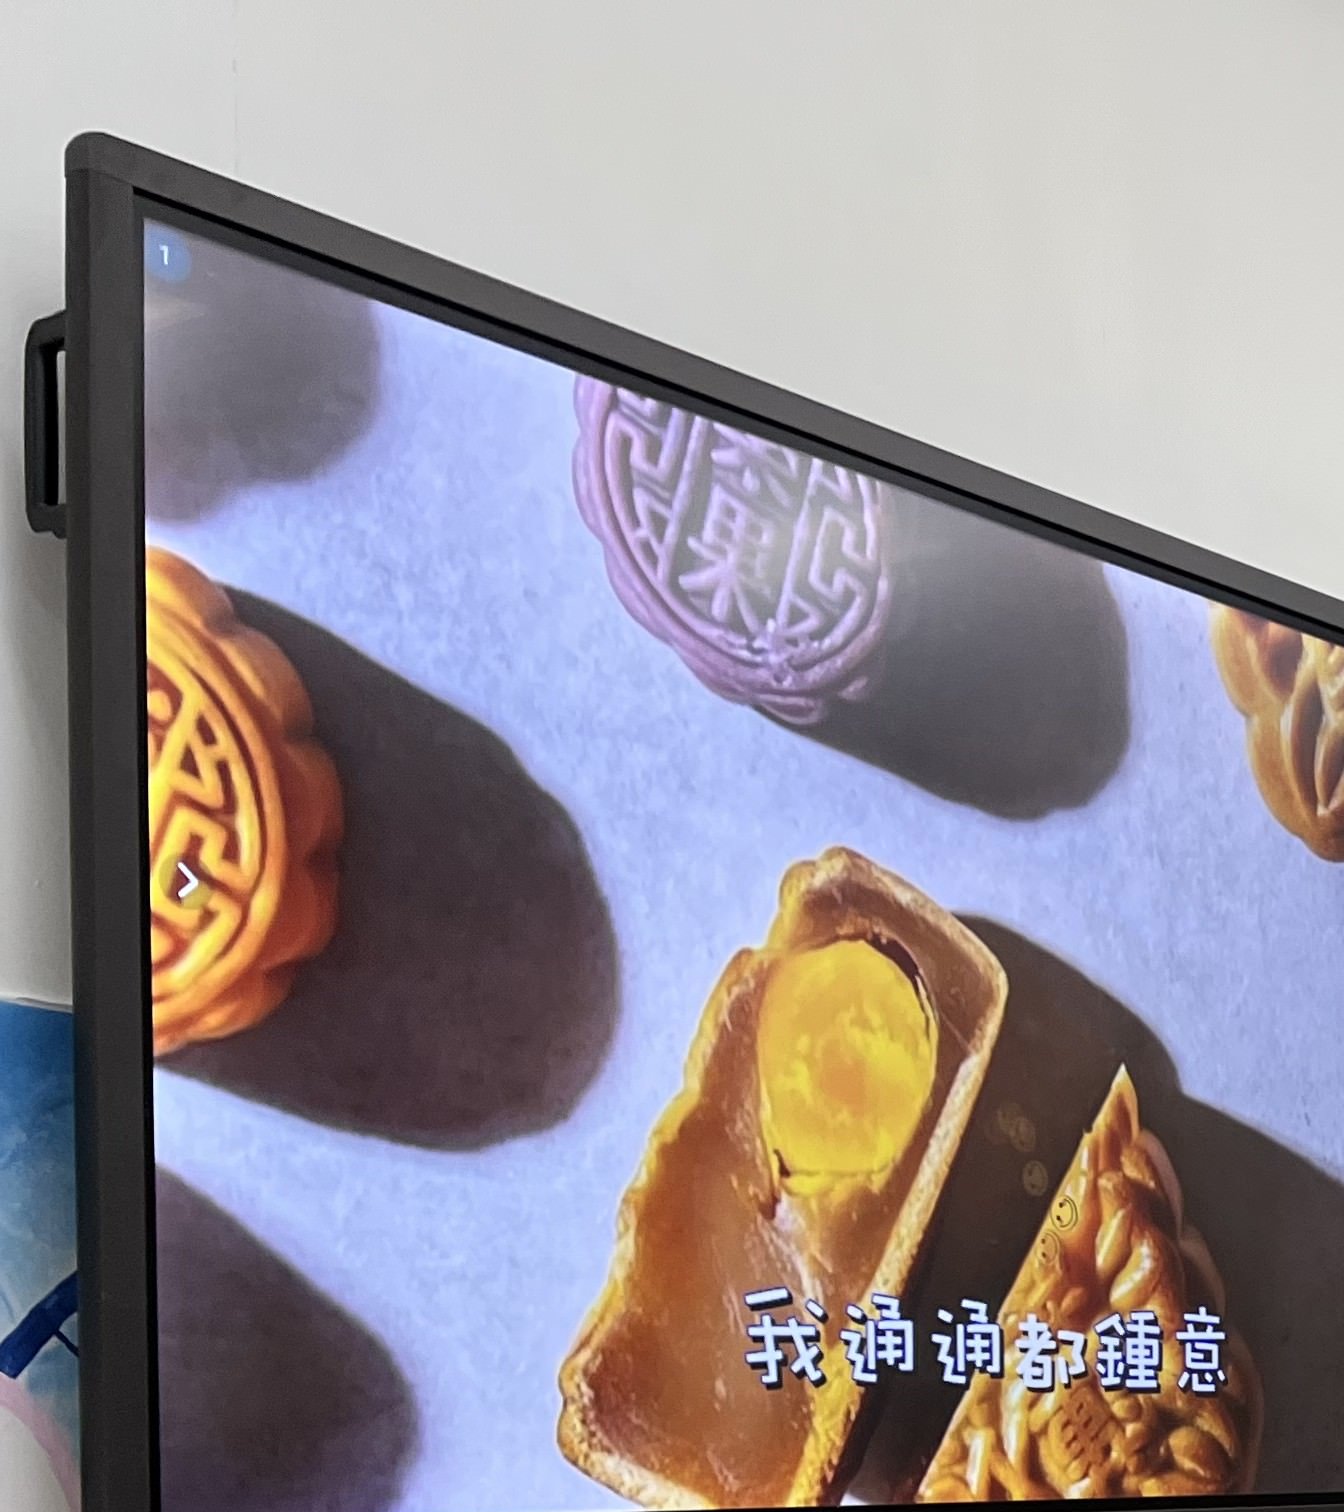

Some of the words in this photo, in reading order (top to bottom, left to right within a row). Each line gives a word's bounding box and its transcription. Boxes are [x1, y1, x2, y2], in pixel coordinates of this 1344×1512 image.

[160, 245, 171, 265] 1
[744, 1286, 1227, 1392] 我通通都鍾意
